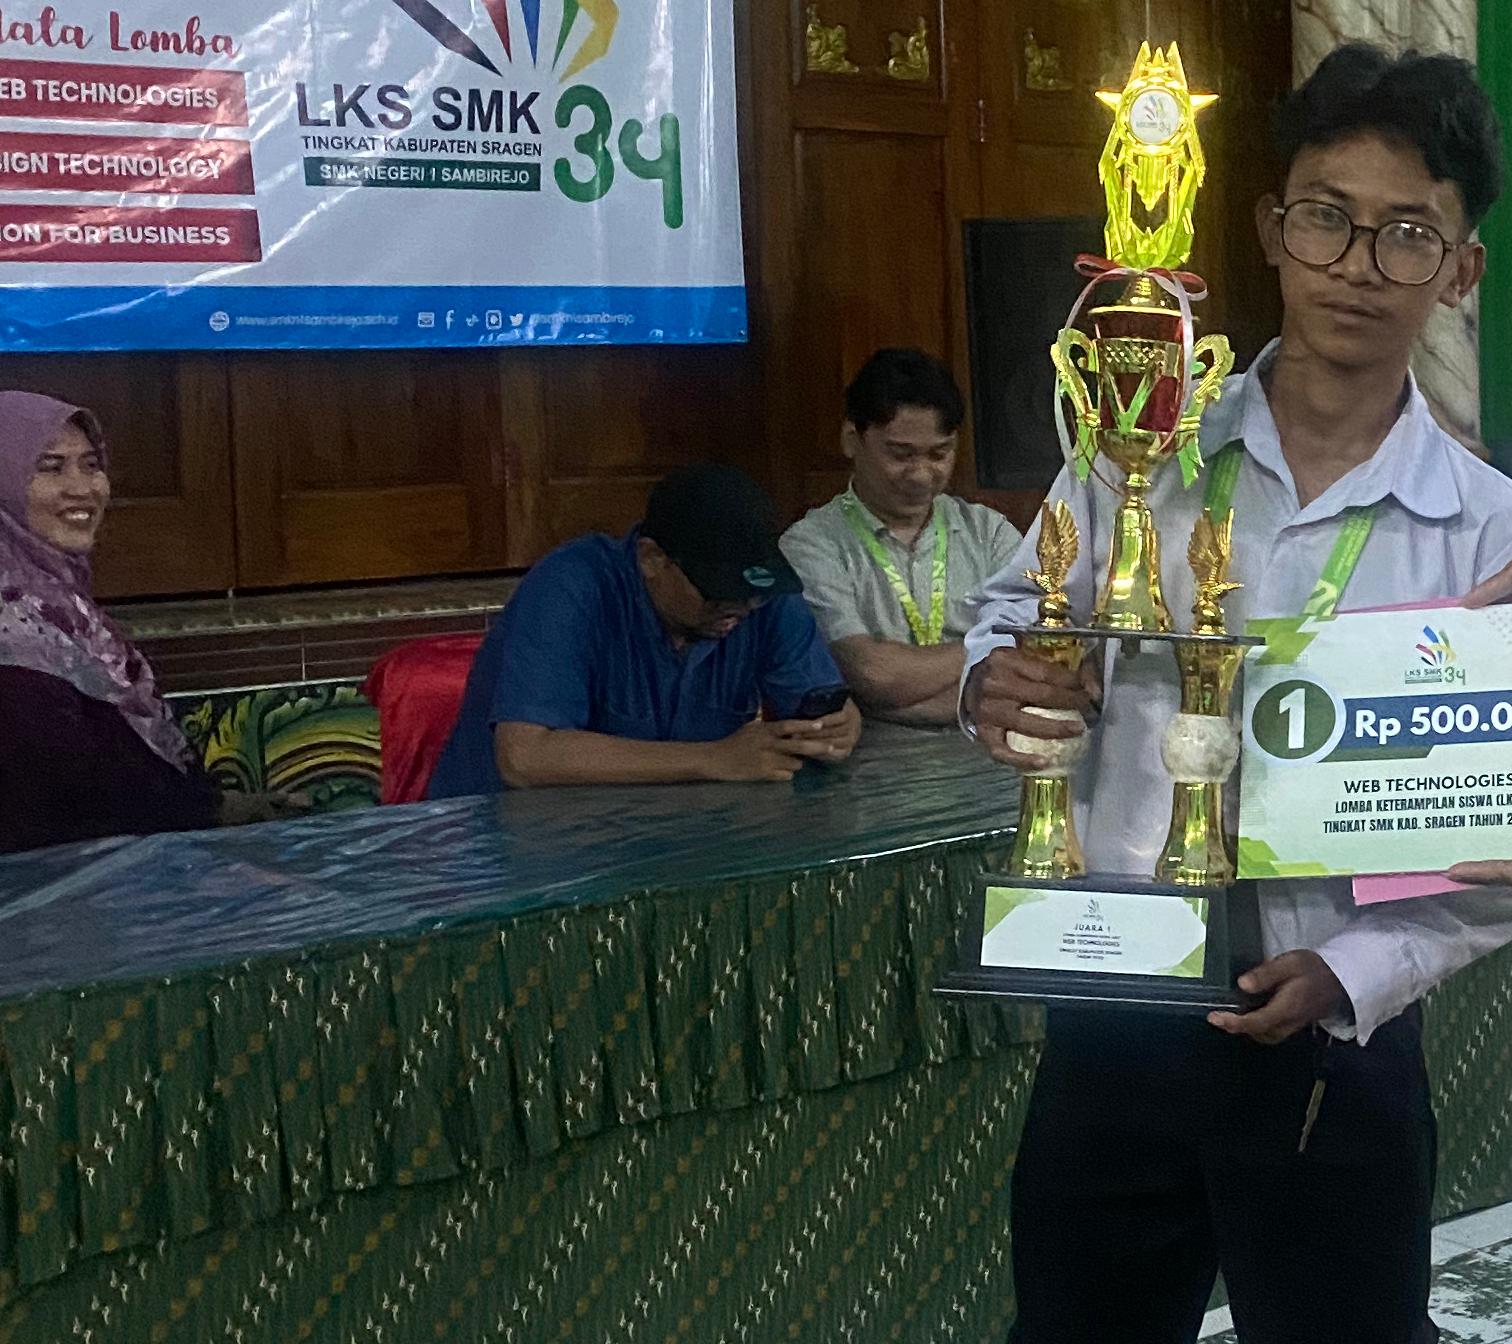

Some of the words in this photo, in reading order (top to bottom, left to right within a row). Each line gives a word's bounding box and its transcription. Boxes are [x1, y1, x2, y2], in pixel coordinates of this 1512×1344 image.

[109, 10, 242, 59] Lomba
[33, 78, 219, 109] TECHNOLOGIES
[296, 82, 412, 130] LKS
[432, 86, 541, 135] SMK
[554, 83, 684, 230] 34
[301, 135, 379, 152] TINGKAT
[383, 136, 477, 155] KABUPATEN
[481, 139, 542, 157] SRAGEN
[54, 153, 222, 180] TECHNOLOGY
[320, 163, 360, 180] SMK
[364, 165, 425, 182] NEGERI
[441, 167, 530, 185] SAMBIREJO
[50, 225, 102, 245] FOR
[109, 225, 231, 245] BUSINESS
[1444, 666, 1466, 685] 34
[1279, 687, 1306, 750] 1
[1354, 709, 1402, 745] Rp
[1343, 779, 1381, 794] WEB
[1335, 800, 1373, 814] LOMBA
[1376, 796, 1455, 812] KETERAMPILAN
[1458, 793, 1493, 809] SISWA
[1322, 819, 1366, 834] TINGKAT
[1369, 818, 1395, 832] SMK
[1424, 815, 1466, 830] SRAGEN
[1468, 813, 1504, 827] TAHUN
